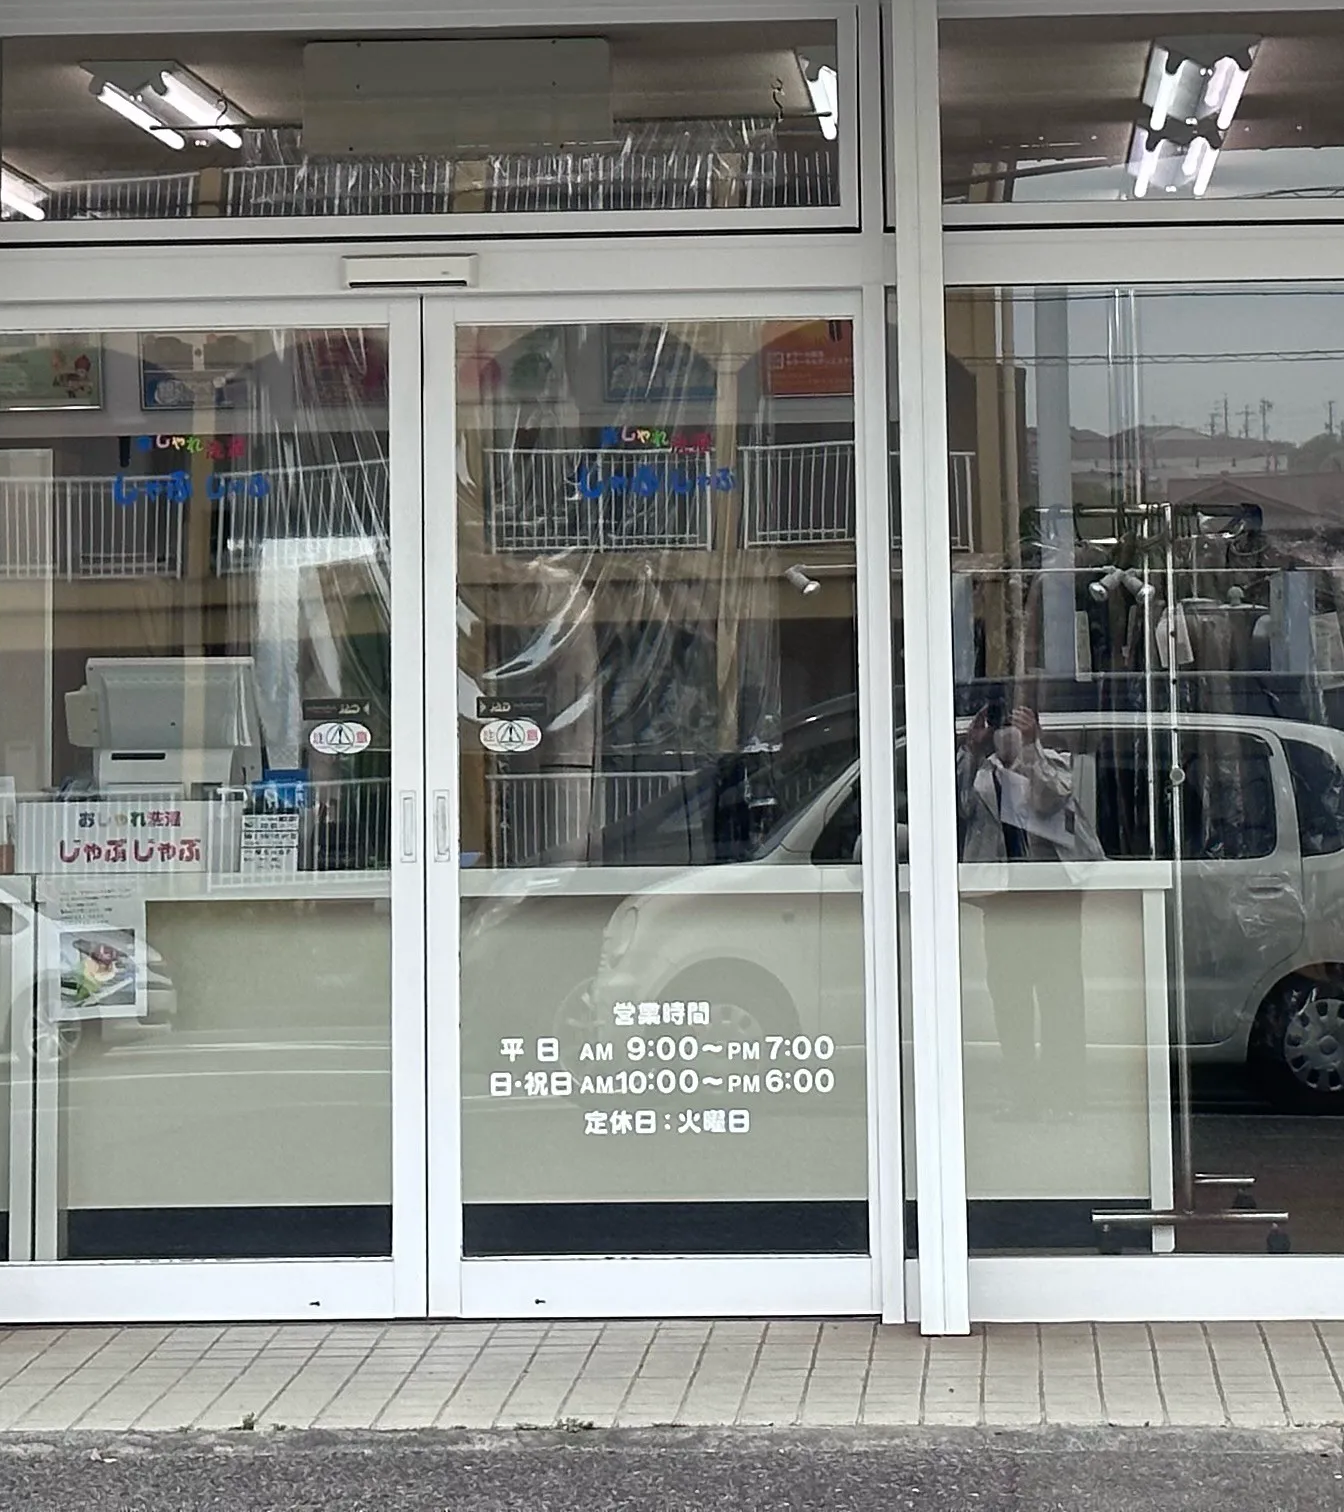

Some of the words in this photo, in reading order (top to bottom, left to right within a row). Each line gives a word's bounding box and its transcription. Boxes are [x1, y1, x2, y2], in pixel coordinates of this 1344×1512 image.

[612, 1001, 710, 1026] 営業時間
[579, 1043, 613, 1061] AM
